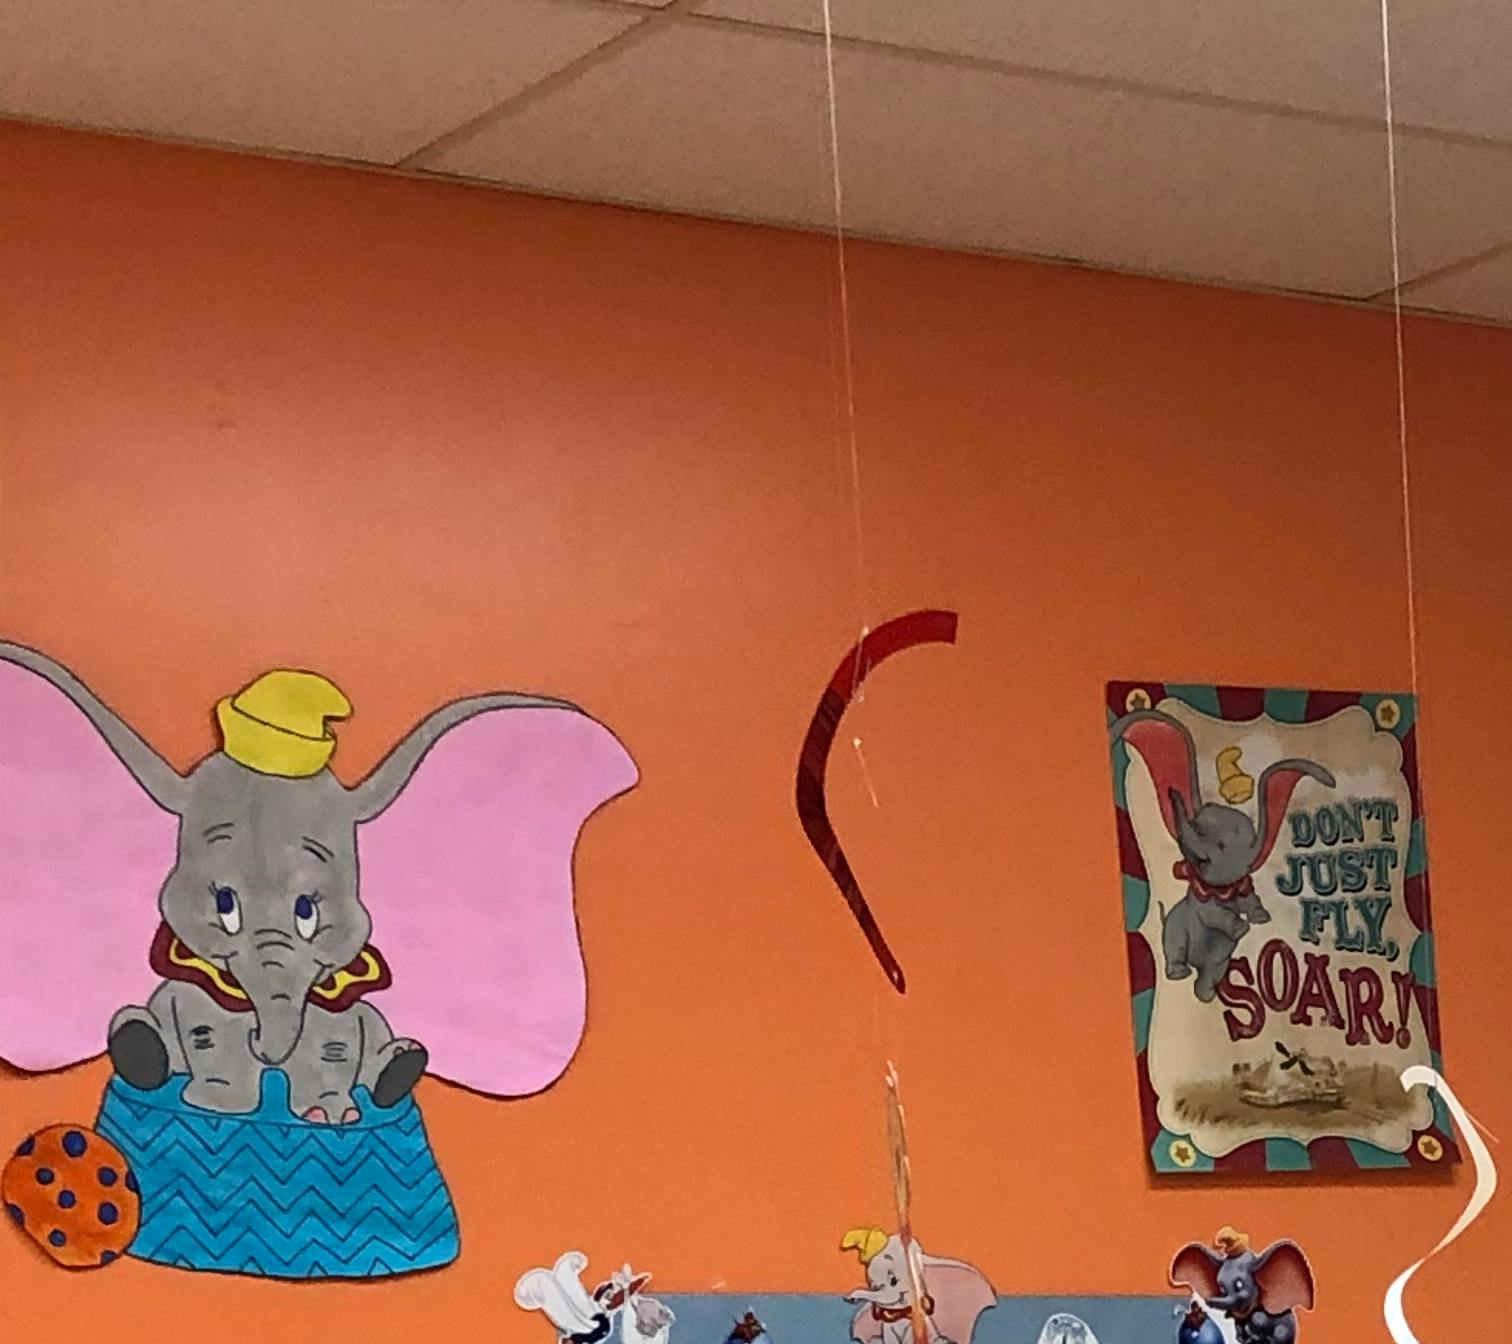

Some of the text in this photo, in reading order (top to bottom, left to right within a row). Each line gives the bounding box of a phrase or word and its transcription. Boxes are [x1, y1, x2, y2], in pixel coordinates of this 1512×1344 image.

[1287, 798, 1399, 847] DON'T
[1276, 848, 1399, 896] JUST
[1298, 897, 1401, 961] FLY,
[1217, 938, 1416, 1049] SOAR!
